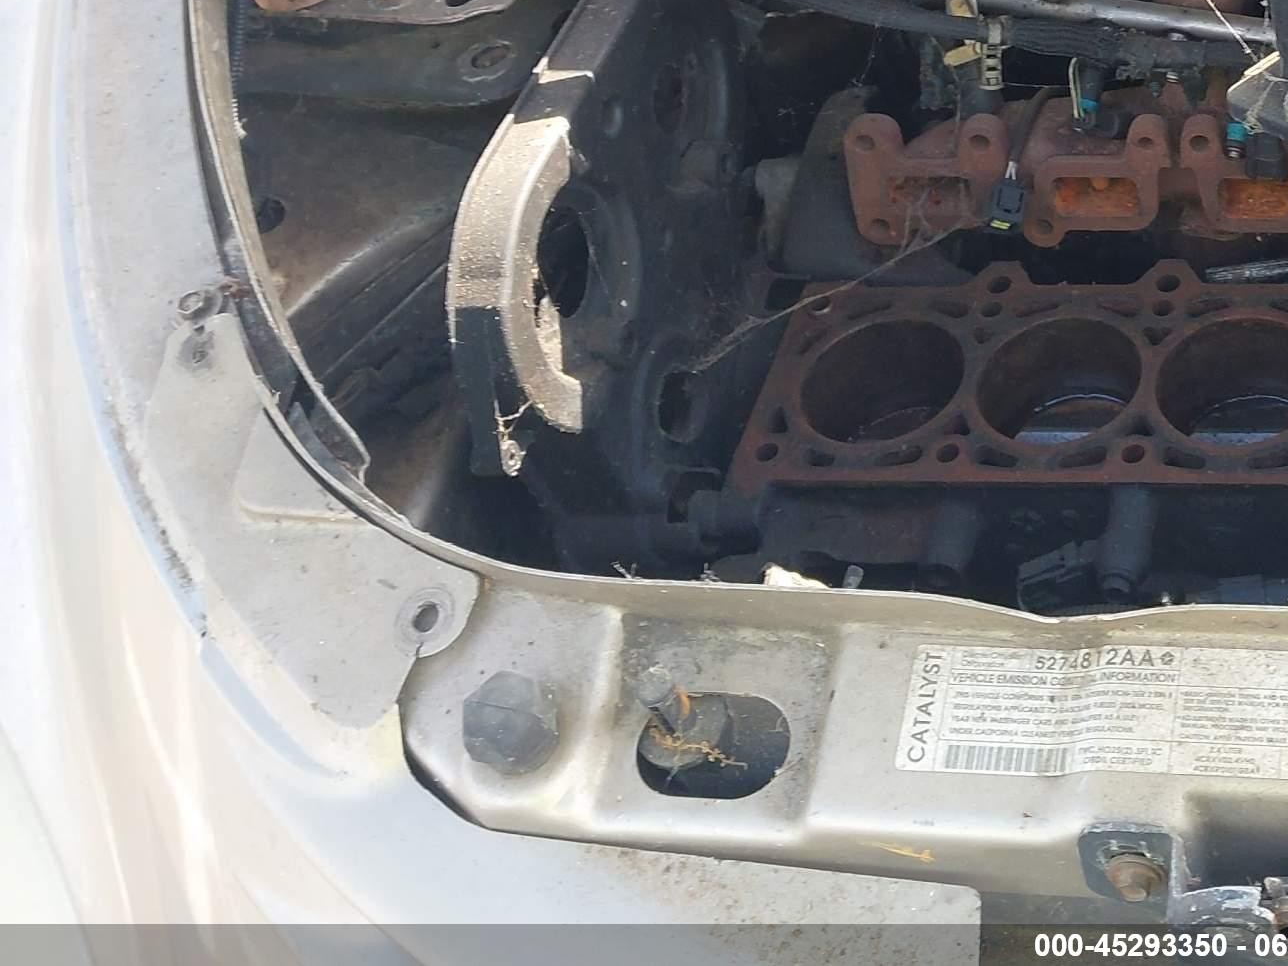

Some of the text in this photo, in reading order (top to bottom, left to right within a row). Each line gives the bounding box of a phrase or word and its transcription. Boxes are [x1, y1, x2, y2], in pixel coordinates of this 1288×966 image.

[906, 652, 944, 763] CATALYST
[951, 672, 995, 684] VEHICLE
[997, 674, 1047, 686] EMISSION
[1100, 672, 1176, 683] INFORMATION
